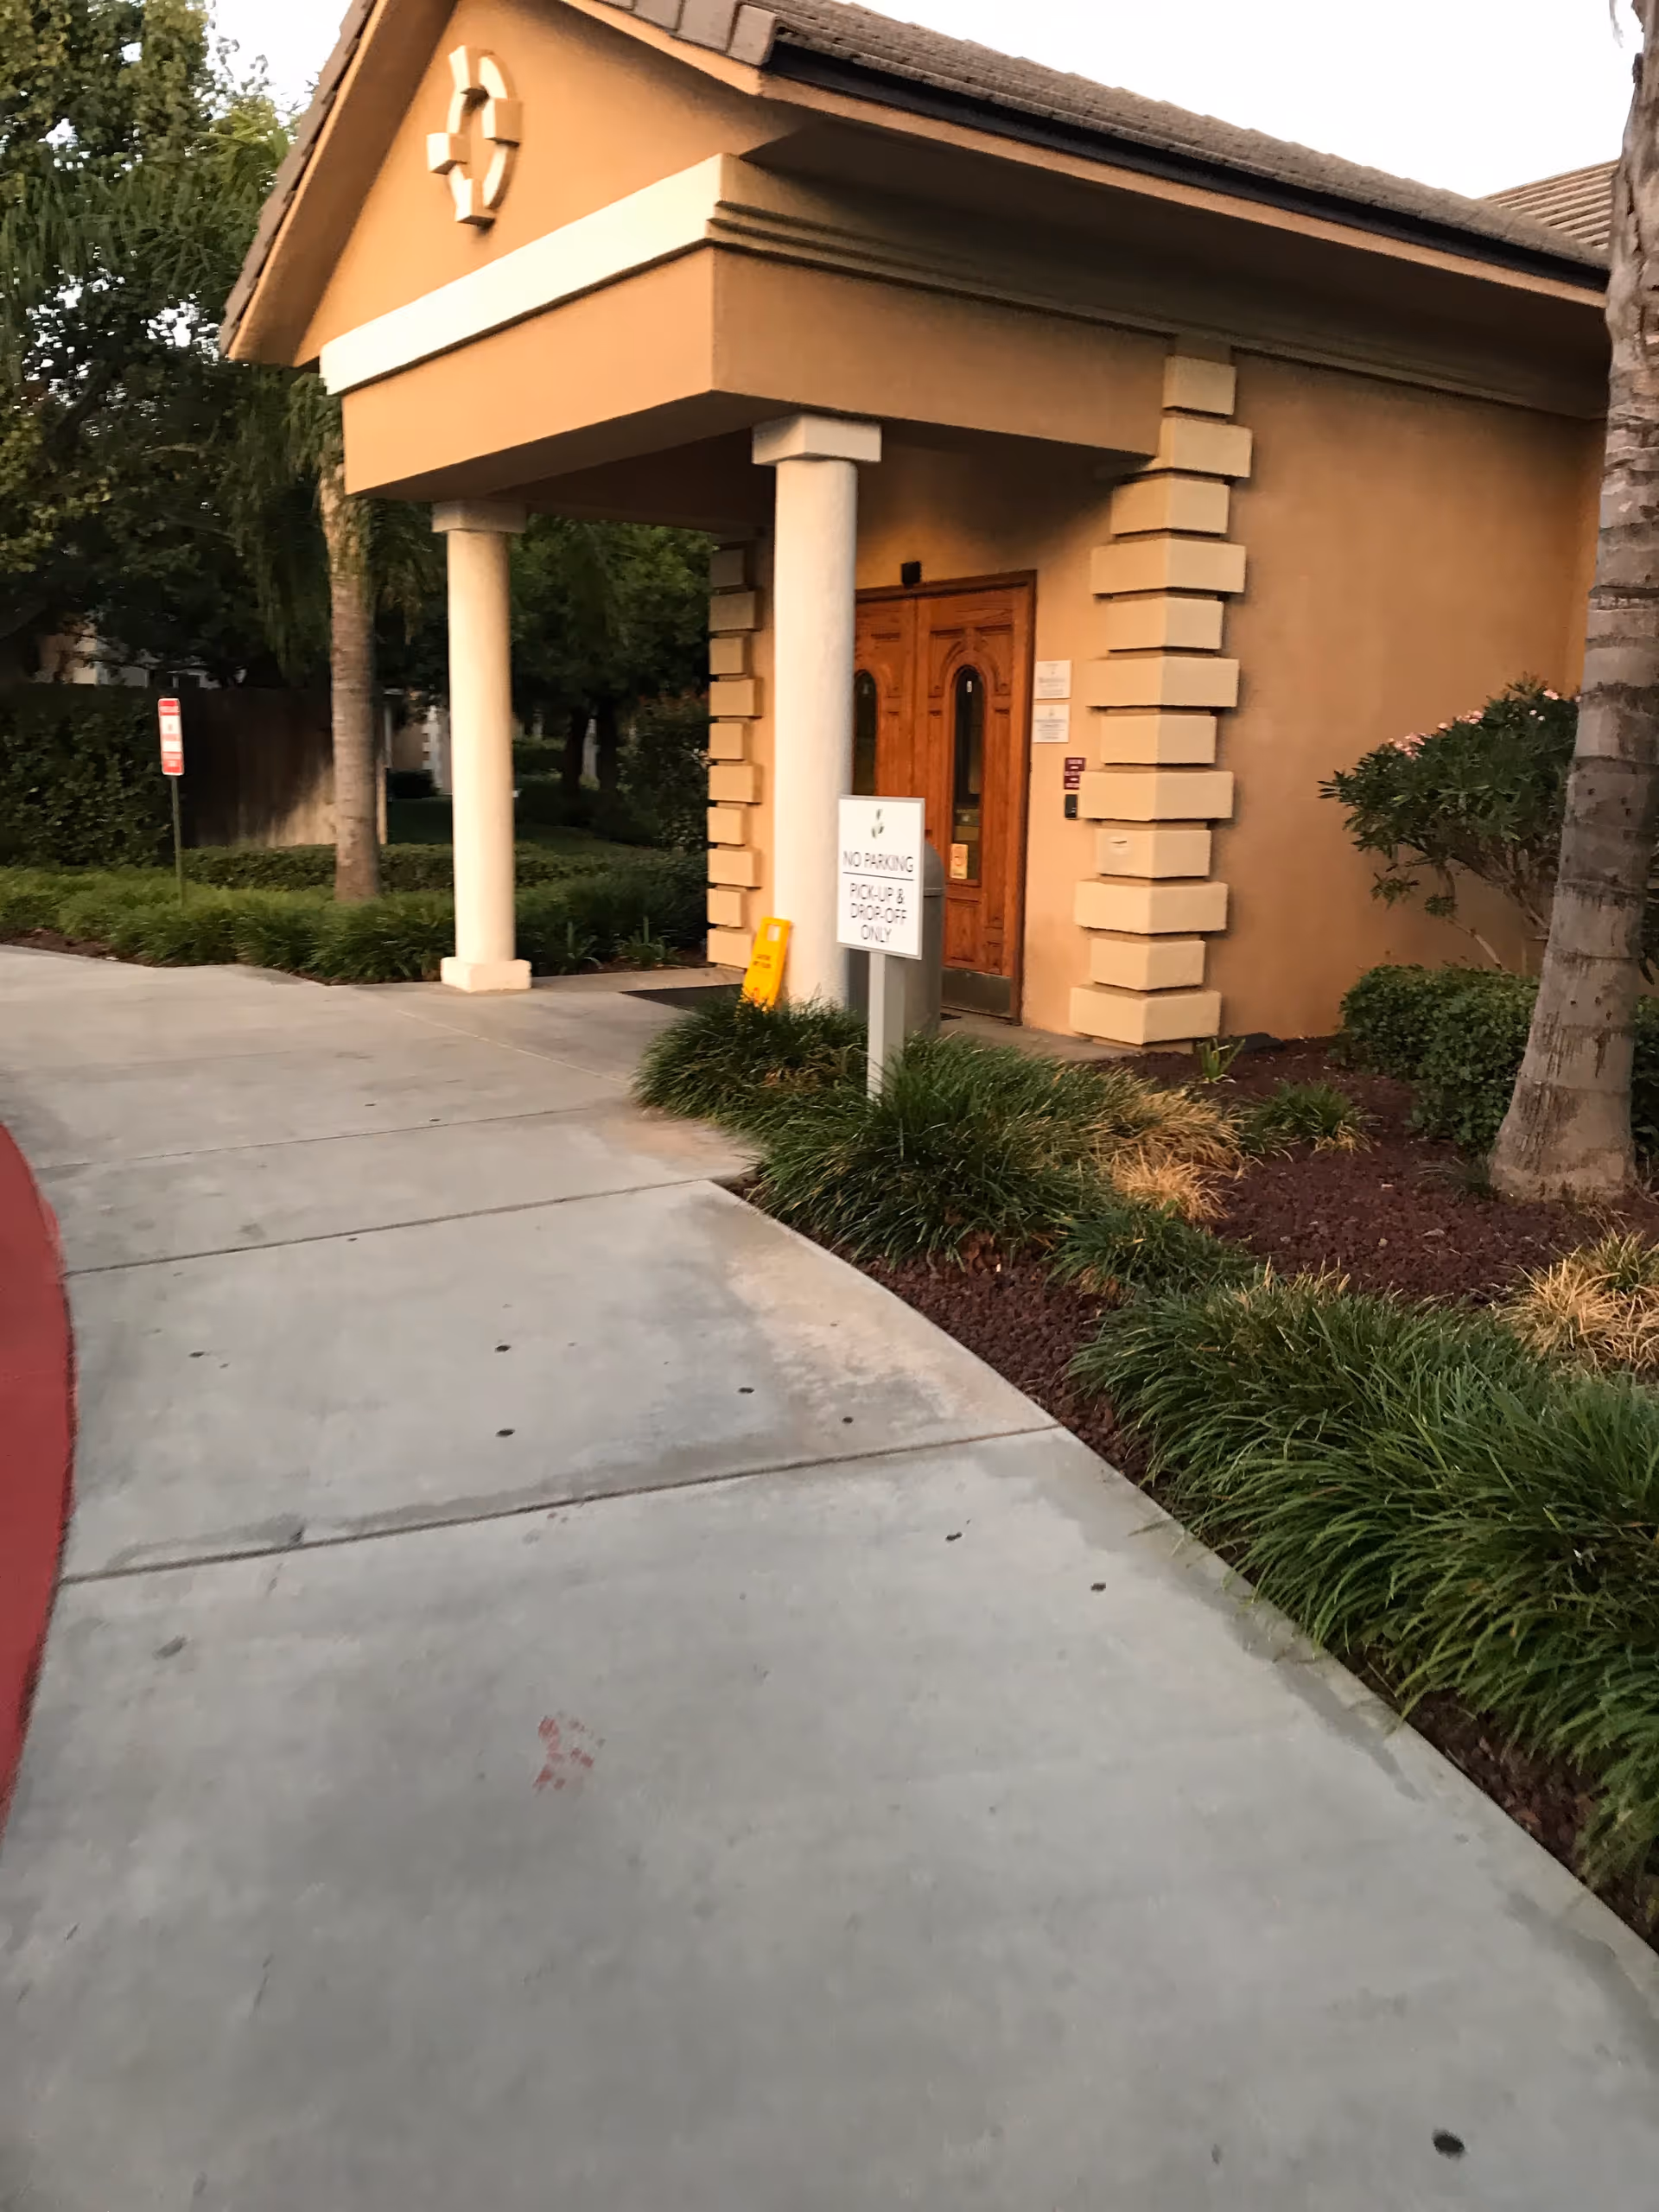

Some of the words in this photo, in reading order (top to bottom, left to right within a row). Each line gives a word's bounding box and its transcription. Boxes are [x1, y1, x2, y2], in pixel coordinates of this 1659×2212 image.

[842, 850, 861, 867] NO
[864, 852, 914, 873] PARKING
[849, 882, 894, 902] PICK-UP
[896, 887, 905, 905] &
[850, 902, 907, 925] DROP-OFF
[861, 925, 892, 943] ONLY
